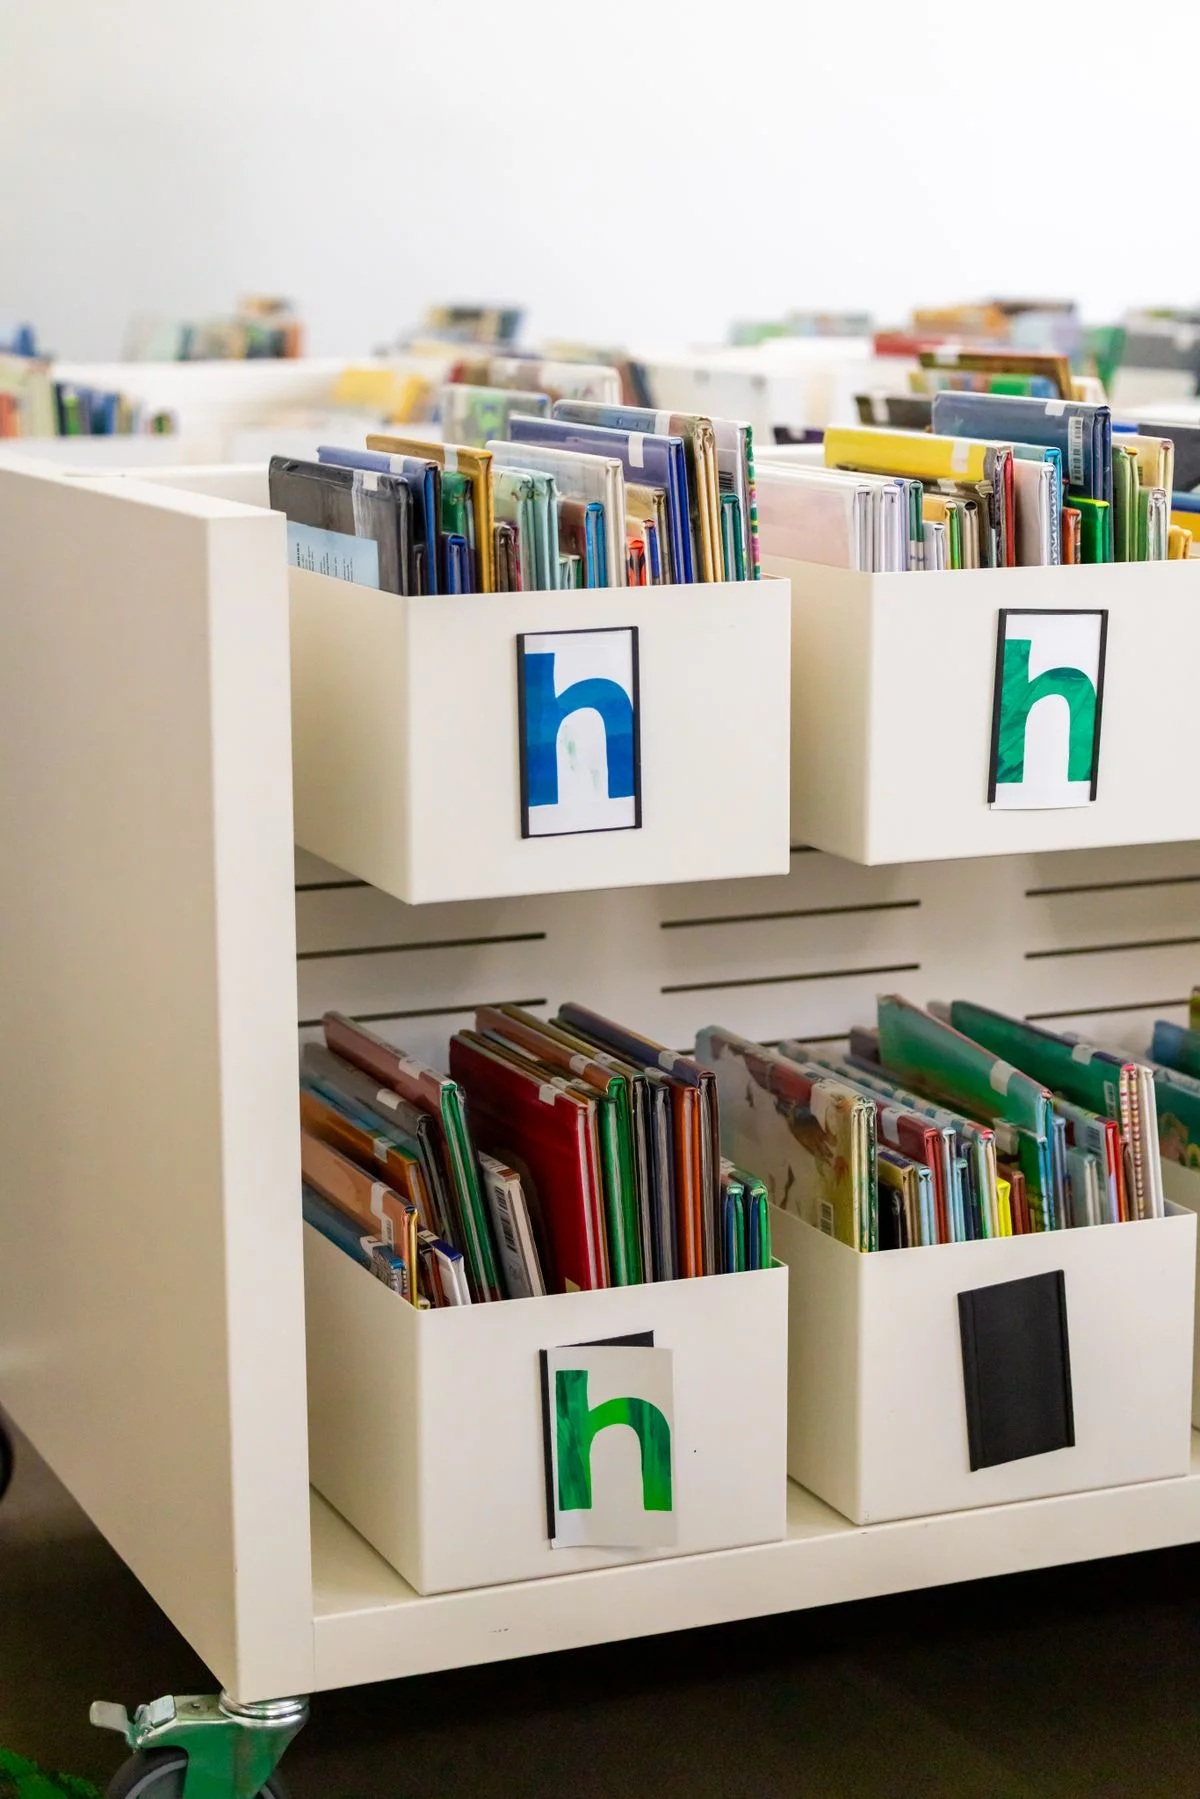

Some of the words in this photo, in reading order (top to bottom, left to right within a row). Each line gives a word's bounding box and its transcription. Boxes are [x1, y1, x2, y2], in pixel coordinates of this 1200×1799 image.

[524, 653, 635, 806] h
[996, 639, 1097, 784] h
[556, 1370, 672, 1511] h
